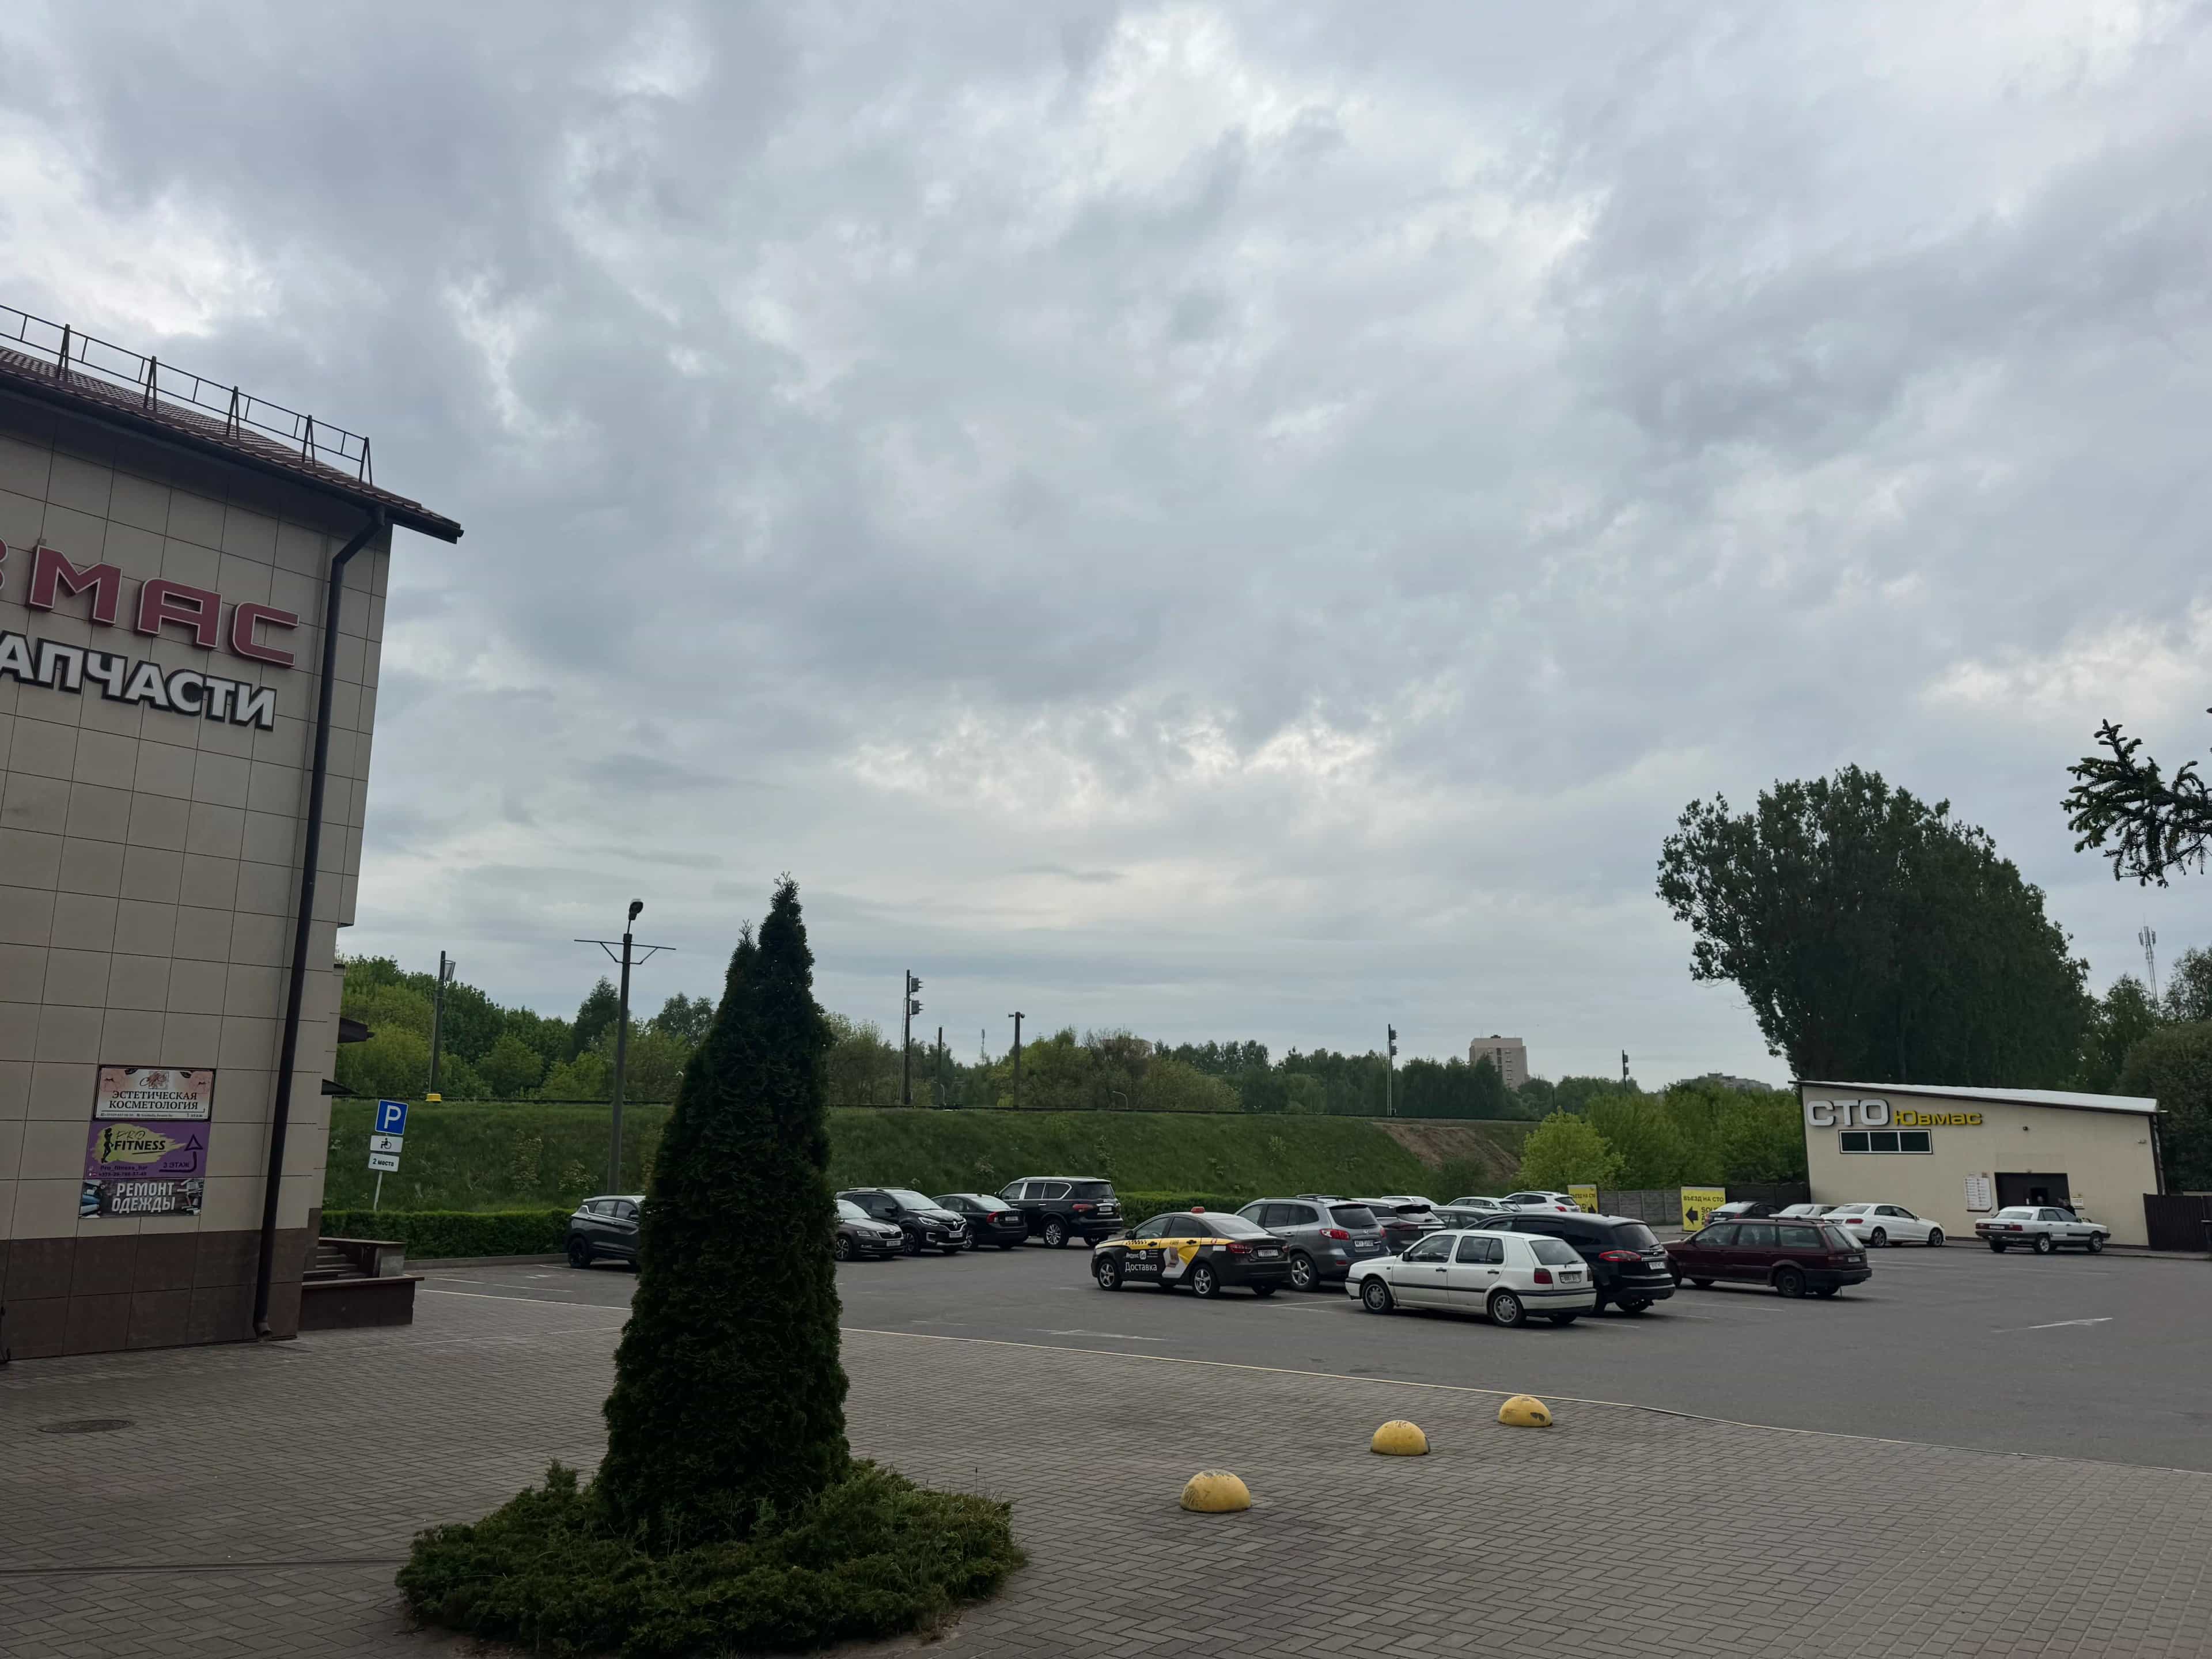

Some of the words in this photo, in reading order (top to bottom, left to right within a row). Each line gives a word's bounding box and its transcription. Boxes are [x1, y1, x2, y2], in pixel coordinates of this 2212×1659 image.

[0, 538, 300, 666] МАС
[112, 1090, 197, 1100] ЭСТЕТИЧЕСКАЯ
[109, 1100, 198, 1109] КОСМЕТОЛОГИЯ
[384, 1105, 402, 1129] P
[1806, 1099, 1890, 1127] СТО
[1893, 1110, 1983, 1126] Ювмас
[116, 1130, 146, 1140] PRO
[113, 1140, 166, 1151] FITNESS
[117, 1182, 175, 1196] РЕМОНТ
[111, 1197, 176, 1214] ОДЕЖДЫ
[1124, 1262, 1157, 1272] Доставка
